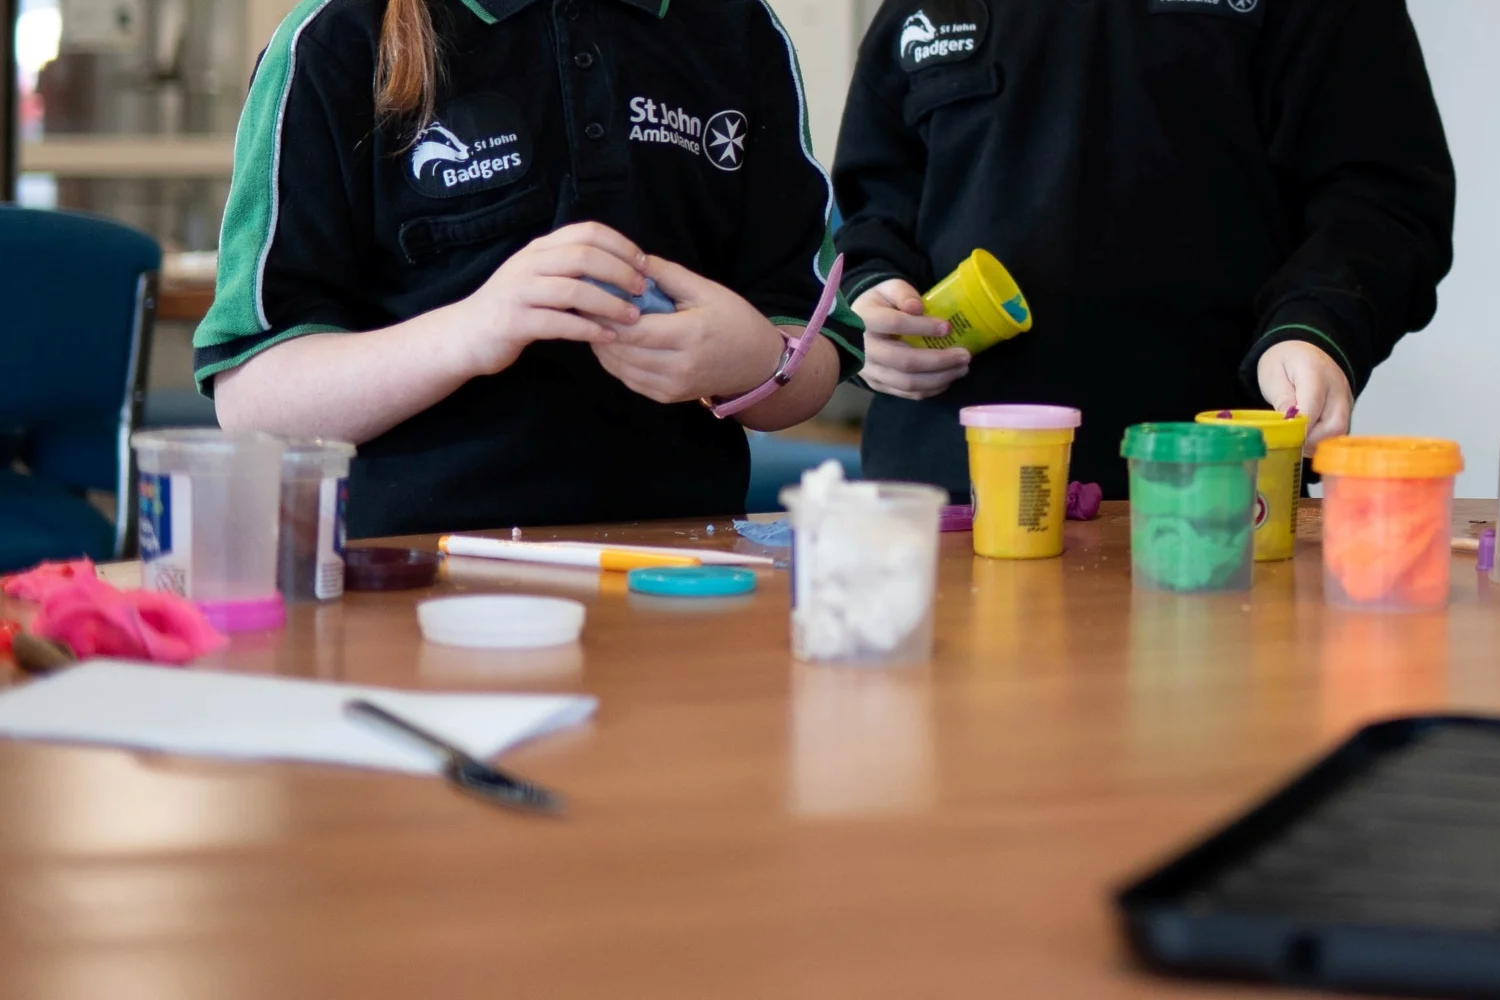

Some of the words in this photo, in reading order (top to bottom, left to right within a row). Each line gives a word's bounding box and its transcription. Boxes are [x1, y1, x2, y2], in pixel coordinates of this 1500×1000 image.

[914, 38, 974, 63] Badgers
[629, 96, 659, 123] St
[660, 102, 702, 138] John
[474, 140, 487, 152] St
[489, 133, 518, 148] John
[629, 124, 700, 155] Ambulance
[442, 152, 522, 187] Badgers
